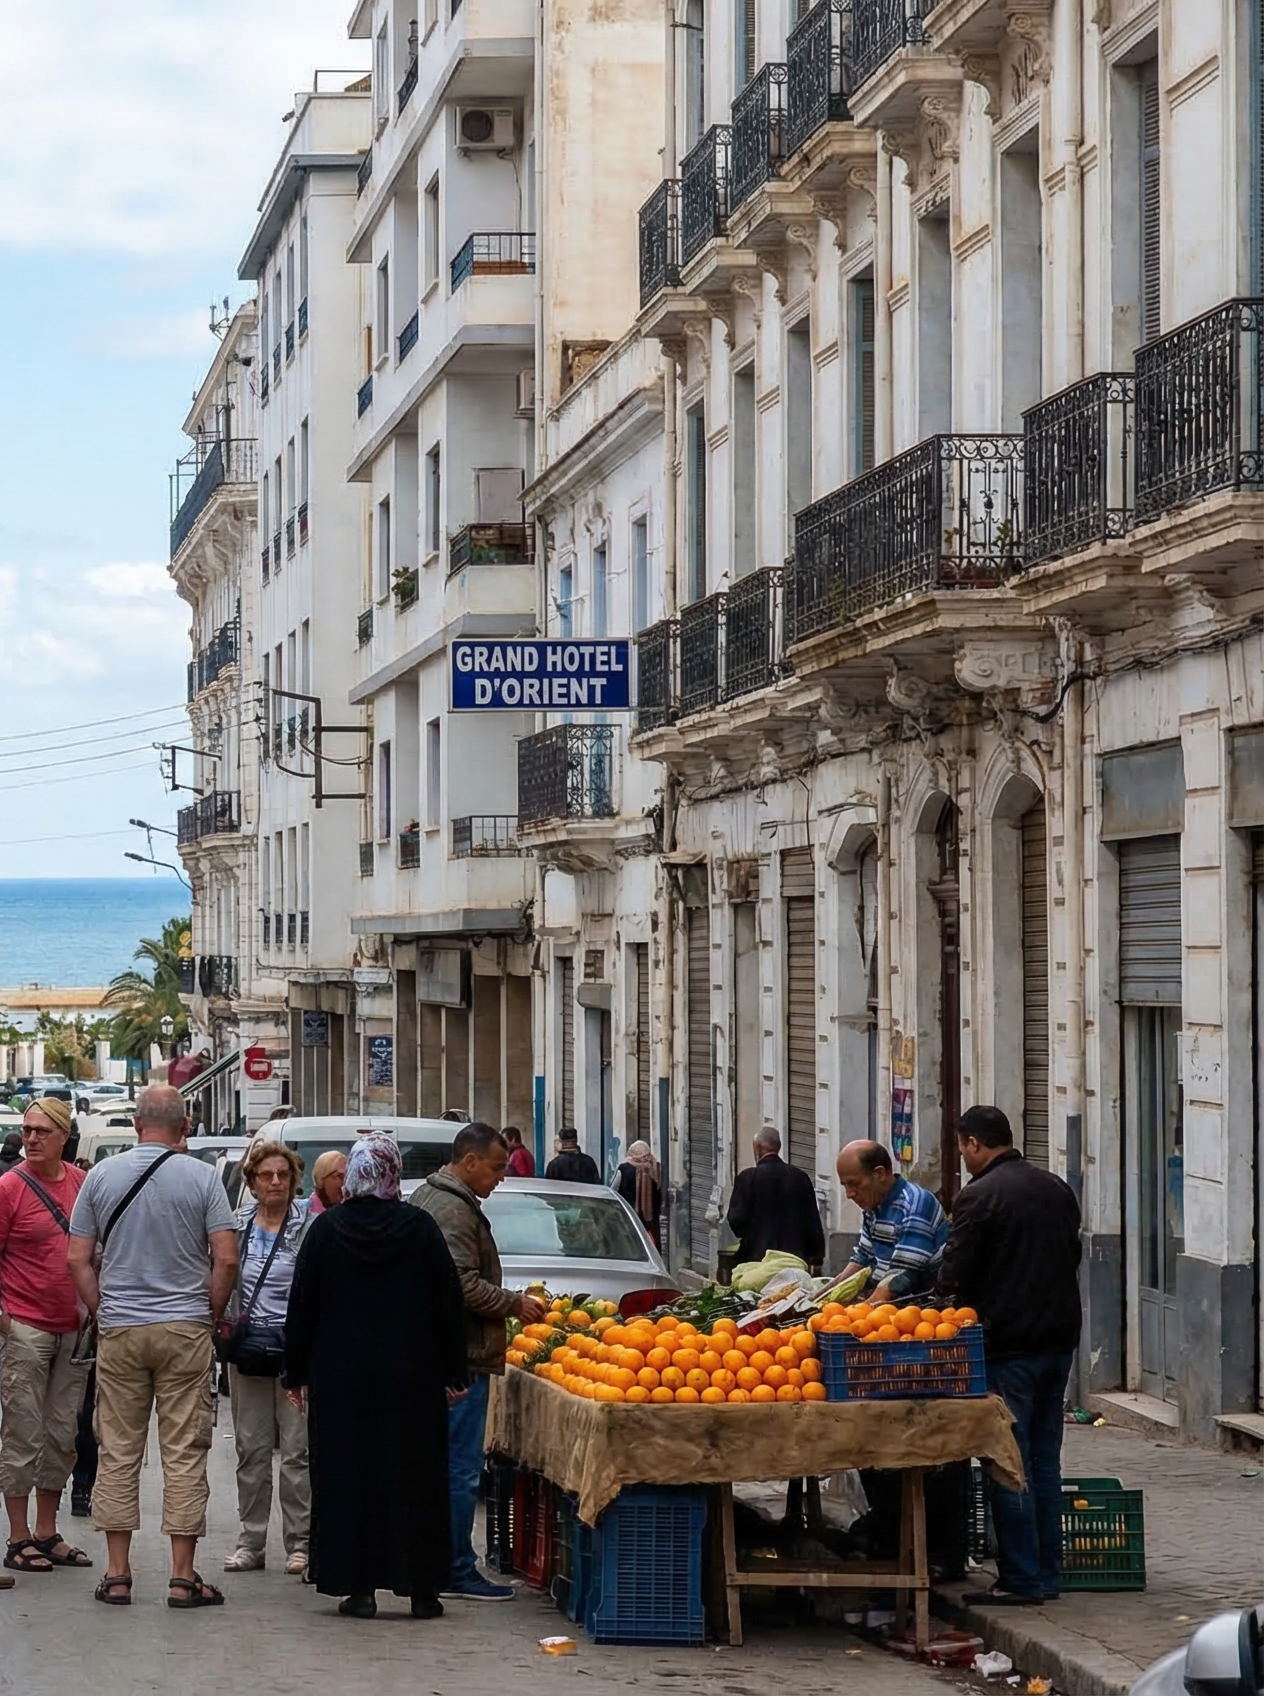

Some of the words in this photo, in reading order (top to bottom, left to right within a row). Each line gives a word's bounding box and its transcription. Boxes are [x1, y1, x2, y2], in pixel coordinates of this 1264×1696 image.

[456, 646, 539, 672] GRAND
[546, 646, 623, 672] HOTEL
[475, 678, 607, 704] D'ORIENT
